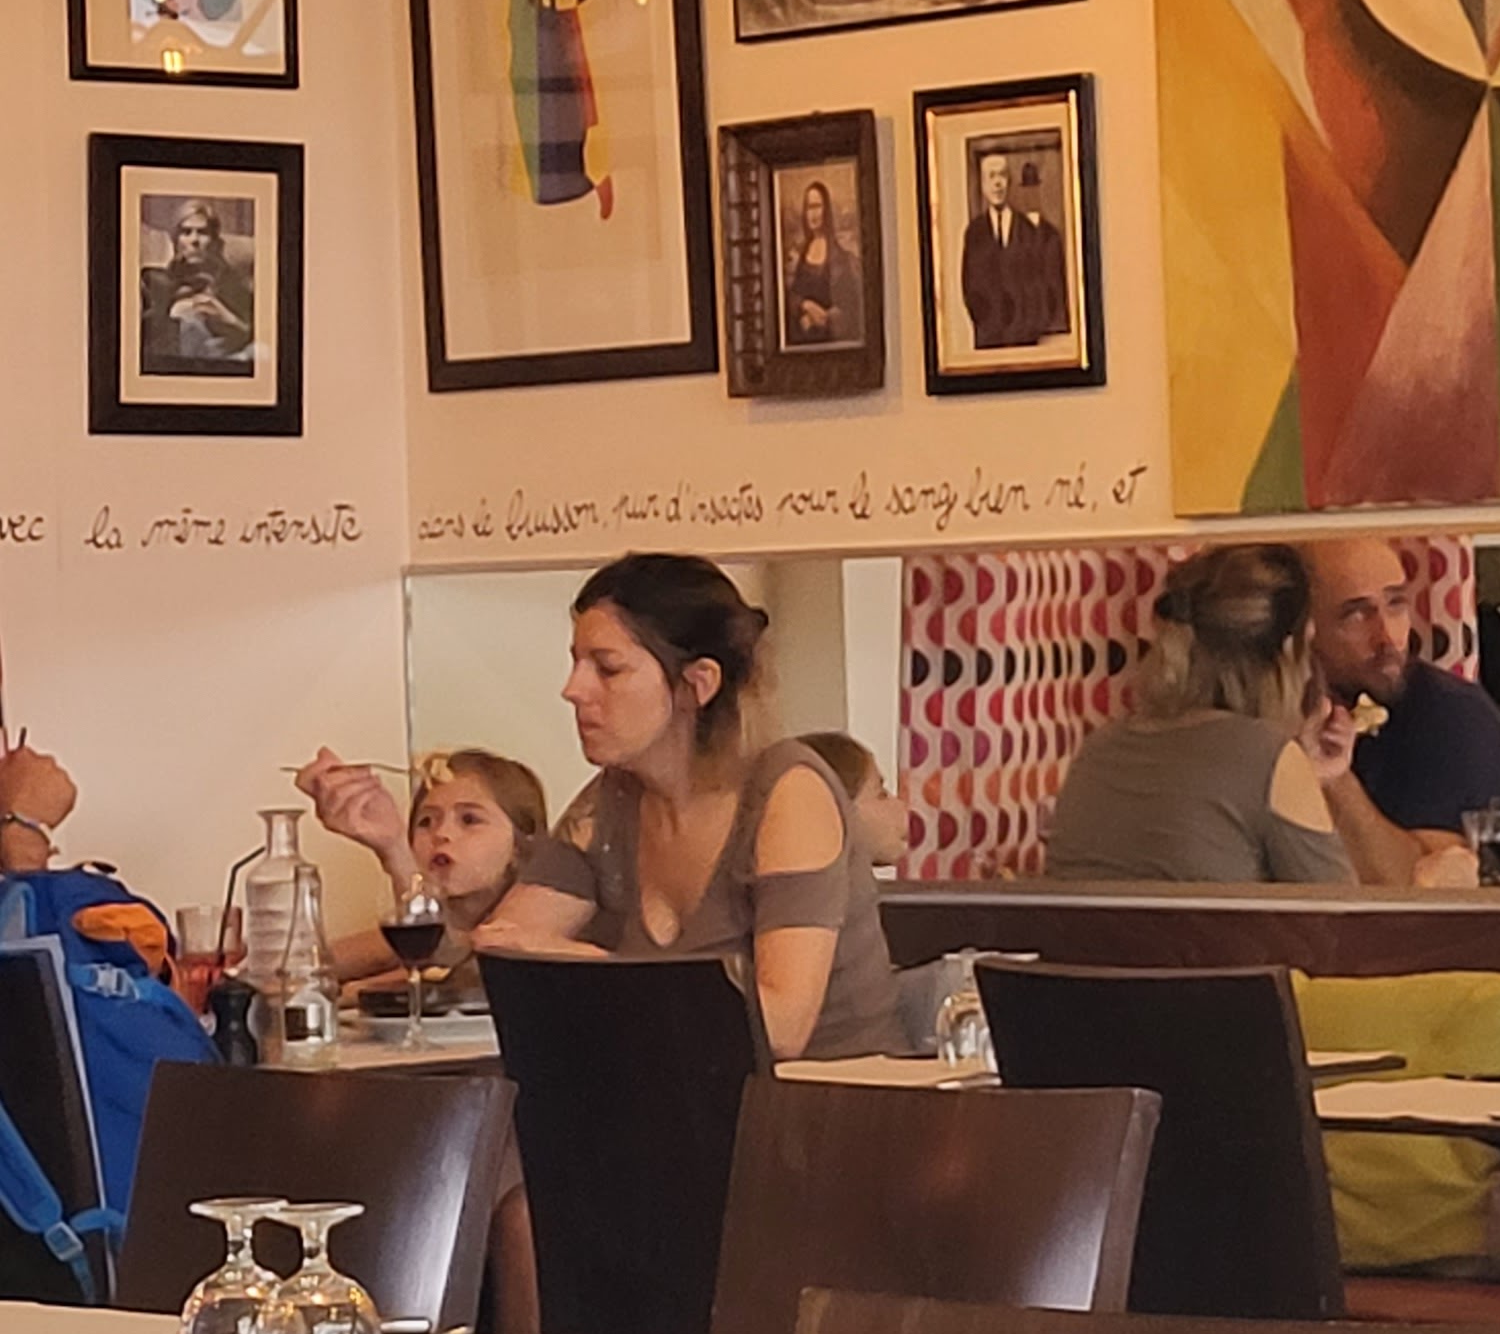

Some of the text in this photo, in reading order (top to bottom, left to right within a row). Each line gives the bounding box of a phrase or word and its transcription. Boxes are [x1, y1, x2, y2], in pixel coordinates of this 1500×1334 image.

[884, 480, 957, 532] sang
[1111, 465, 1149, 506] et
[84, 504, 124, 550] la
